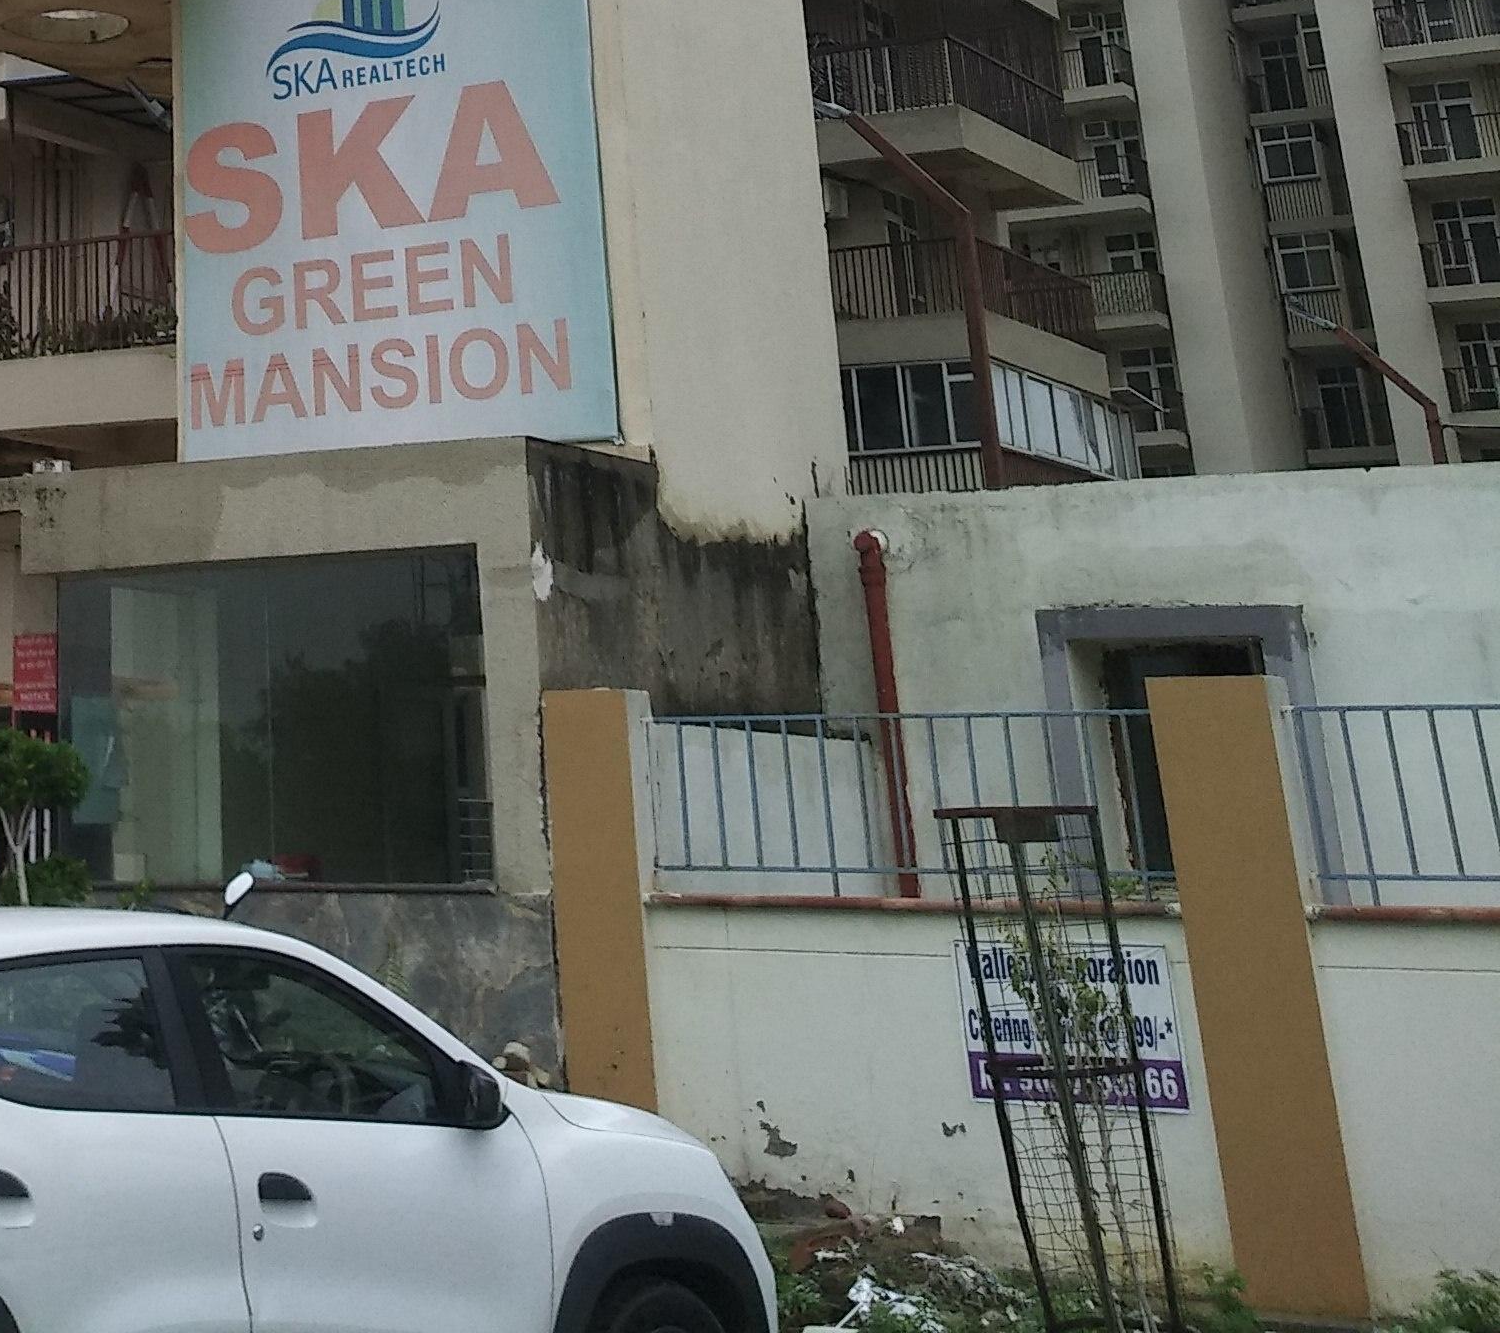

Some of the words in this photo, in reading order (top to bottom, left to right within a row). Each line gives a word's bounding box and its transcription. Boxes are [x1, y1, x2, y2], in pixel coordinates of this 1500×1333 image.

[272, 58, 338, 100] SKA
[341, 53, 446, 89] REALTECH
[184, 80, 562, 254] SKA
[231, 234, 514, 336] GREEN
[190, 318, 573, 430] MANSION
[968, 1008, 1032, 1049] Cering
